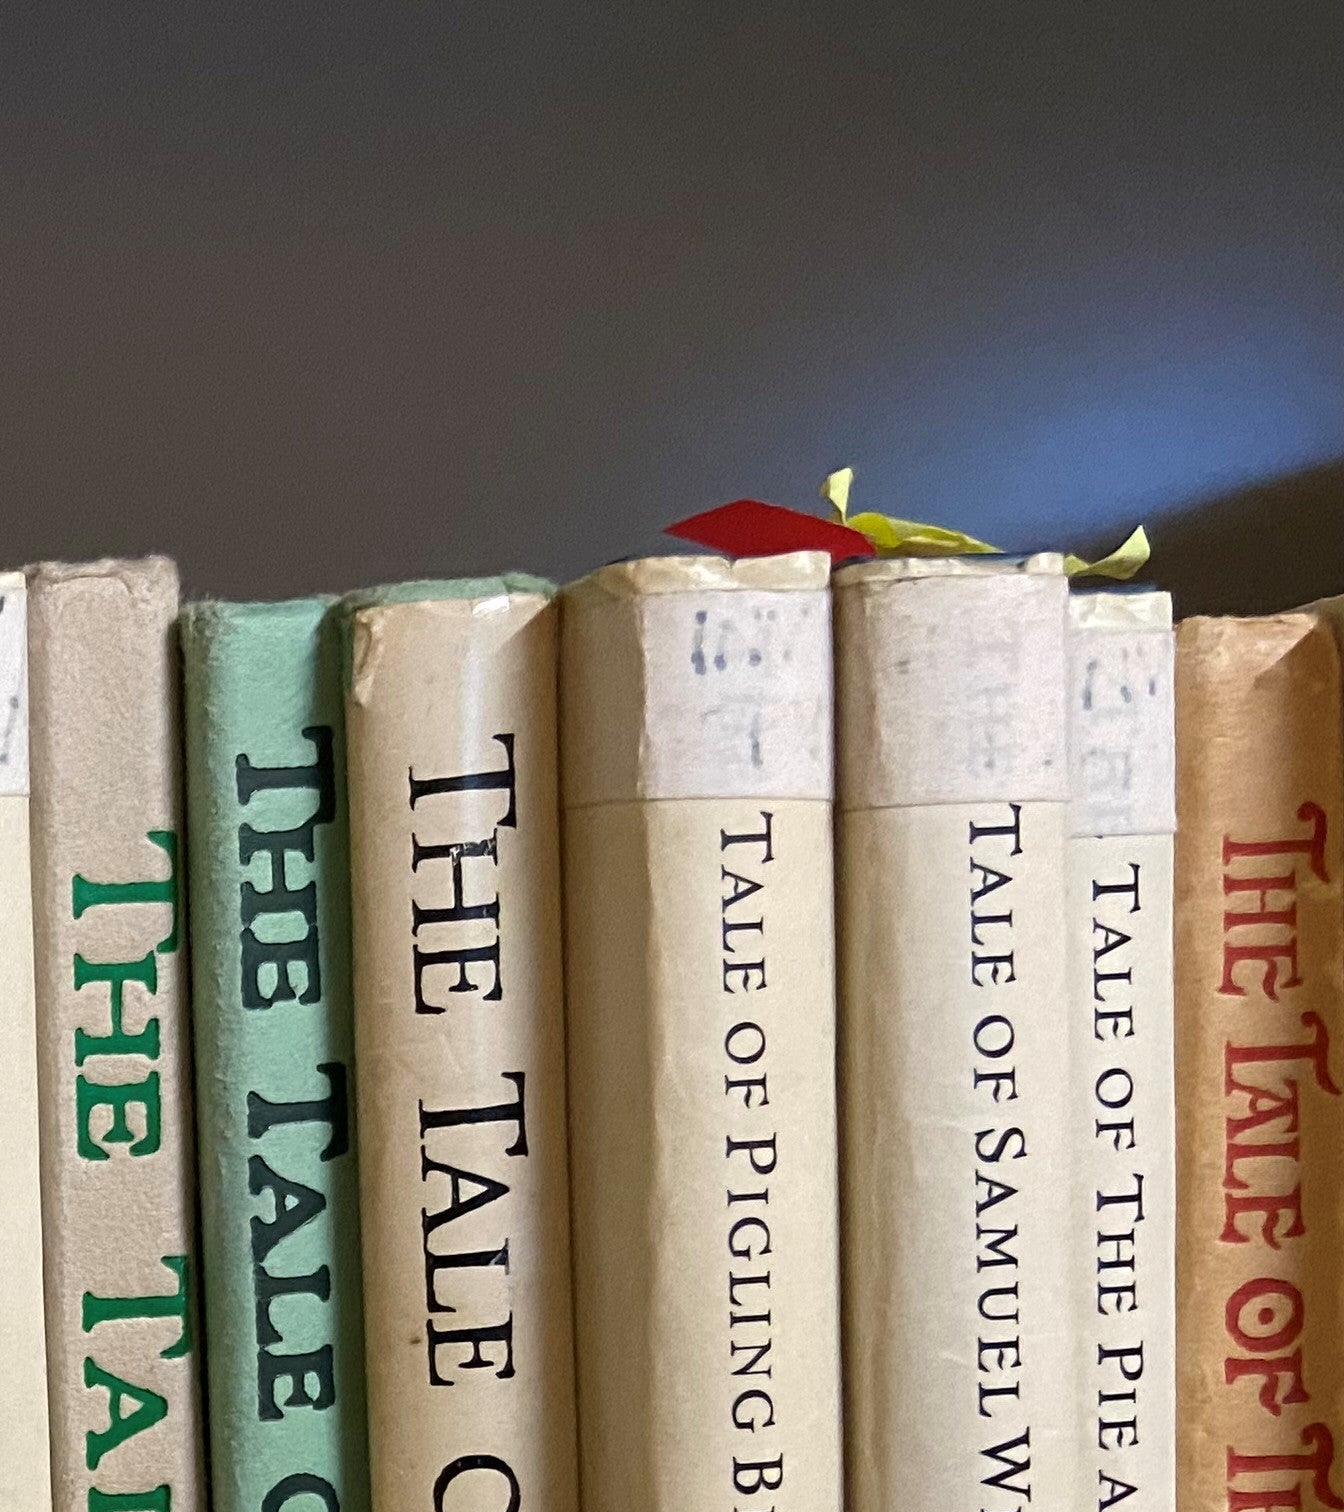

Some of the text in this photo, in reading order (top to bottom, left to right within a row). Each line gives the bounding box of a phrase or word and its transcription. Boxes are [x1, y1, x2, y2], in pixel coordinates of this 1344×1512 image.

[236, 726, 335, 1011] THE
[407, 732, 518, 1016] THE
[721, 810, 774, 994] TALE
[969, 803, 1023, 988] TALE
[1092, 863, 1141, 1042] TALE
[1219, 802, 1330, 1000] THE
[71, 829, 179, 1162] THE
[723, 1020, 769, 1109] OF
[972, 1015, 1020, 1103] OF
[1094, 1069, 1137, 1155] OF
[1218, 1010, 1341, 1250] TALE
[245, 1061, 349, 1421] TALE
[418, 1071, 530, 1387] TALE
[726, 1133, 778, 1434] PIGLING
[975, 1127, 1028, 1419] SAMUEL
[1096, 1176, 1143, 1317] THE
[1098, 1344, 1143, 1450] PIE
[1223, 1278, 1310, 1416] OF
